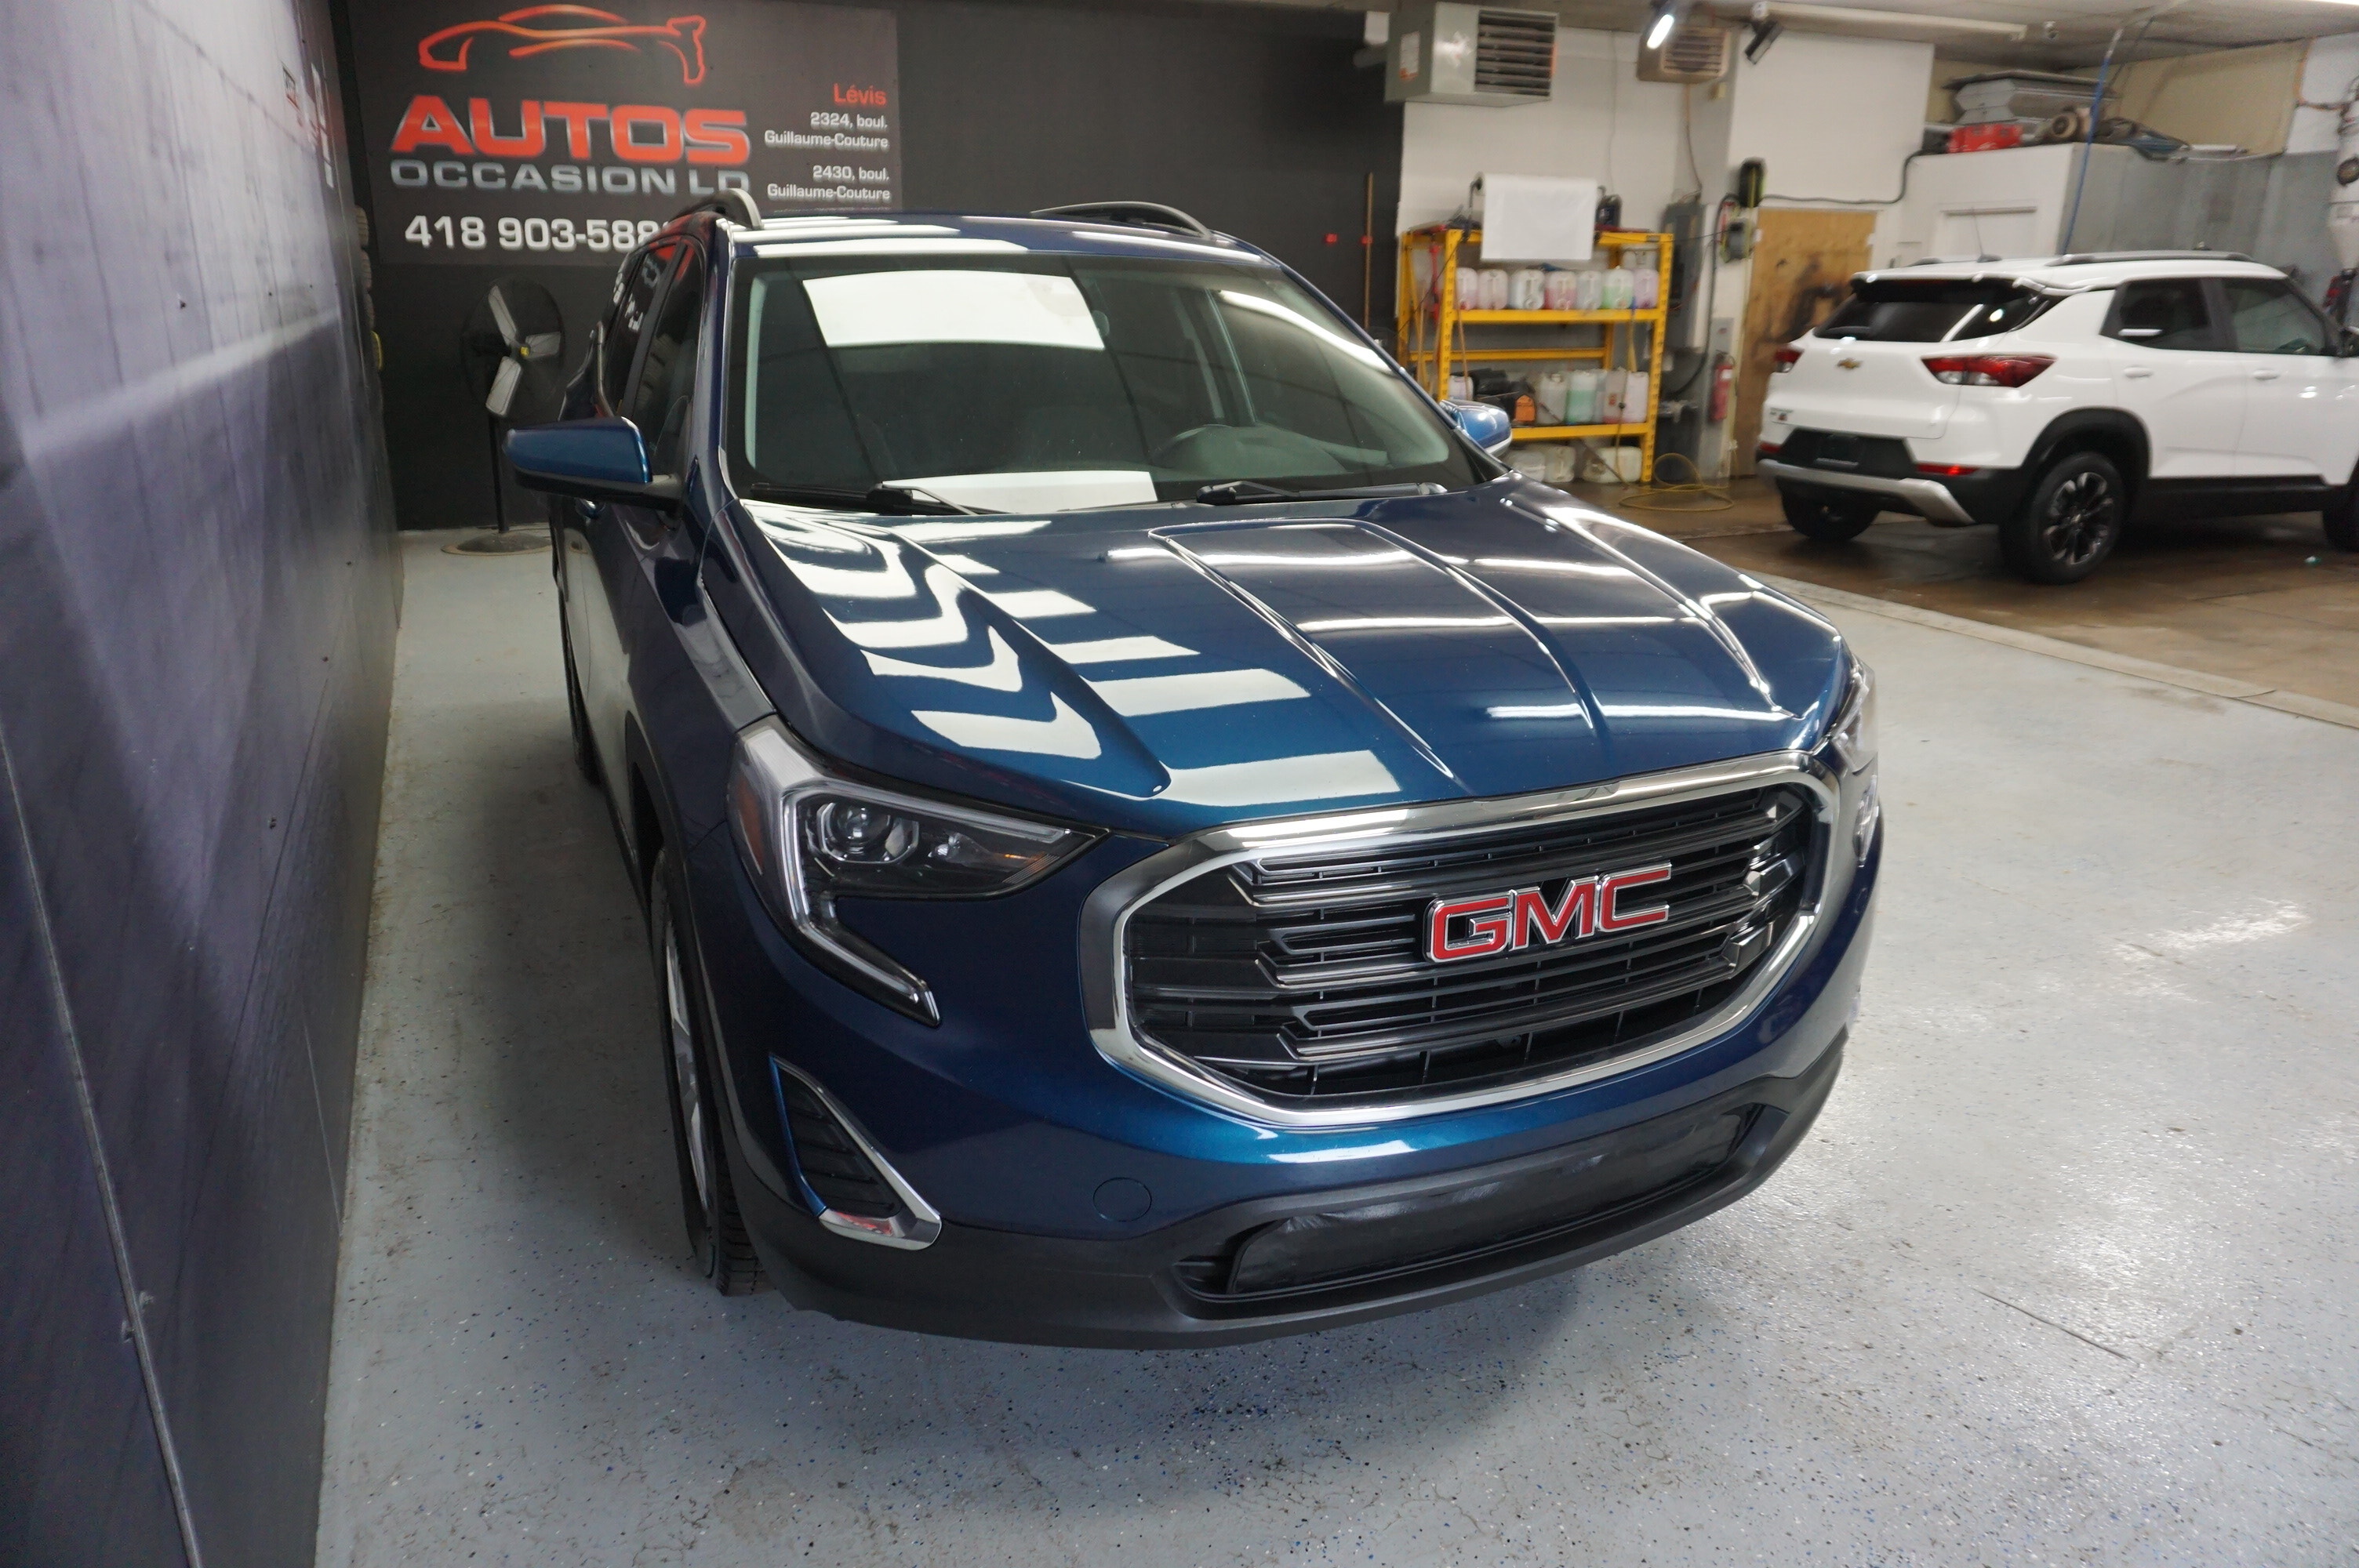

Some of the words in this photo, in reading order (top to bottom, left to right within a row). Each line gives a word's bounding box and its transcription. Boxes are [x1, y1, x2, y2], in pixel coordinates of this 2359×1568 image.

[833, 83, 888, 106] Lévis
[391, 95, 751, 166] AUTOS
[810, 111, 853, 130] 2324,
[856, 114, 888, 130] boul.
[764, 129, 889, 151] Guillaume-Couture
[391, 159, 675, 194] OCCASION
[812, 165, 856, 182] 2430,
[859, 166, 889, 183] boul.
[767, 183, 891, 202] Guillaume-Couture
[405, 215, 486, 249] 418
[497, 216, 669, 252] 903-588
[1423, 862, 1672, 963] GMC
